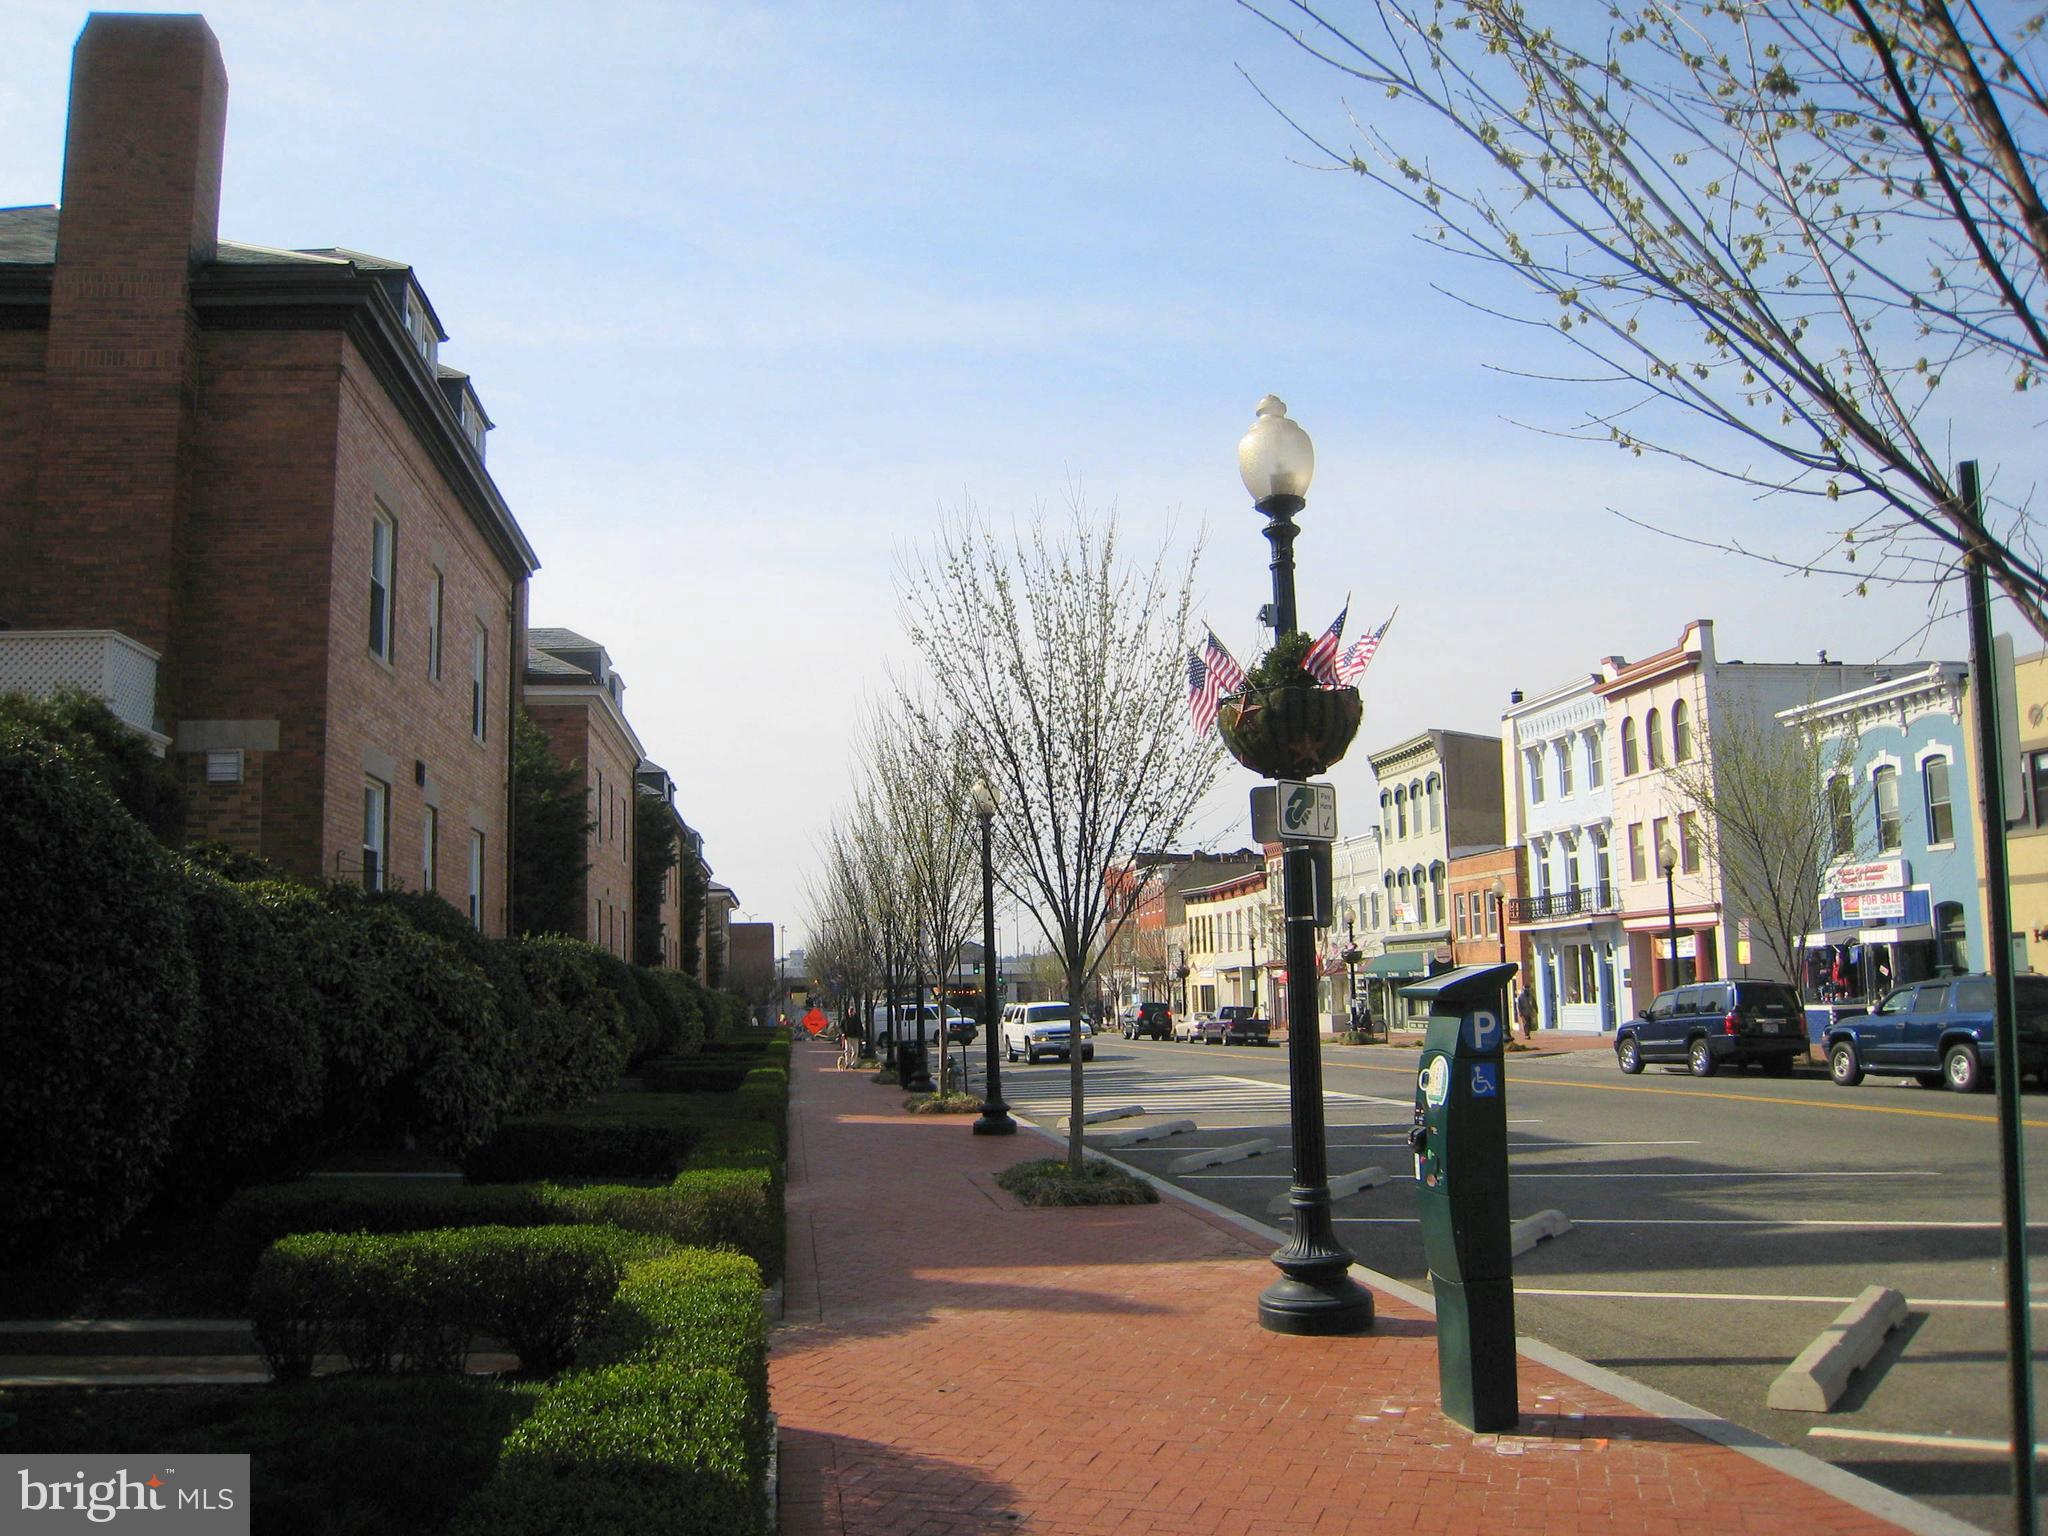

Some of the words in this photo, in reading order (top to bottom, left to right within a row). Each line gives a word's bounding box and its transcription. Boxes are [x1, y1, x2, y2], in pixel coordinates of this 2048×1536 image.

[1320, 792, 1331, 802] Pay
[1320, 802, 1332, 811] Here
[1862, 895, 1878, 906] FOR
[1880, 892, 1902, 904] SALE
[1473, 1011, 1496, 1049] P
